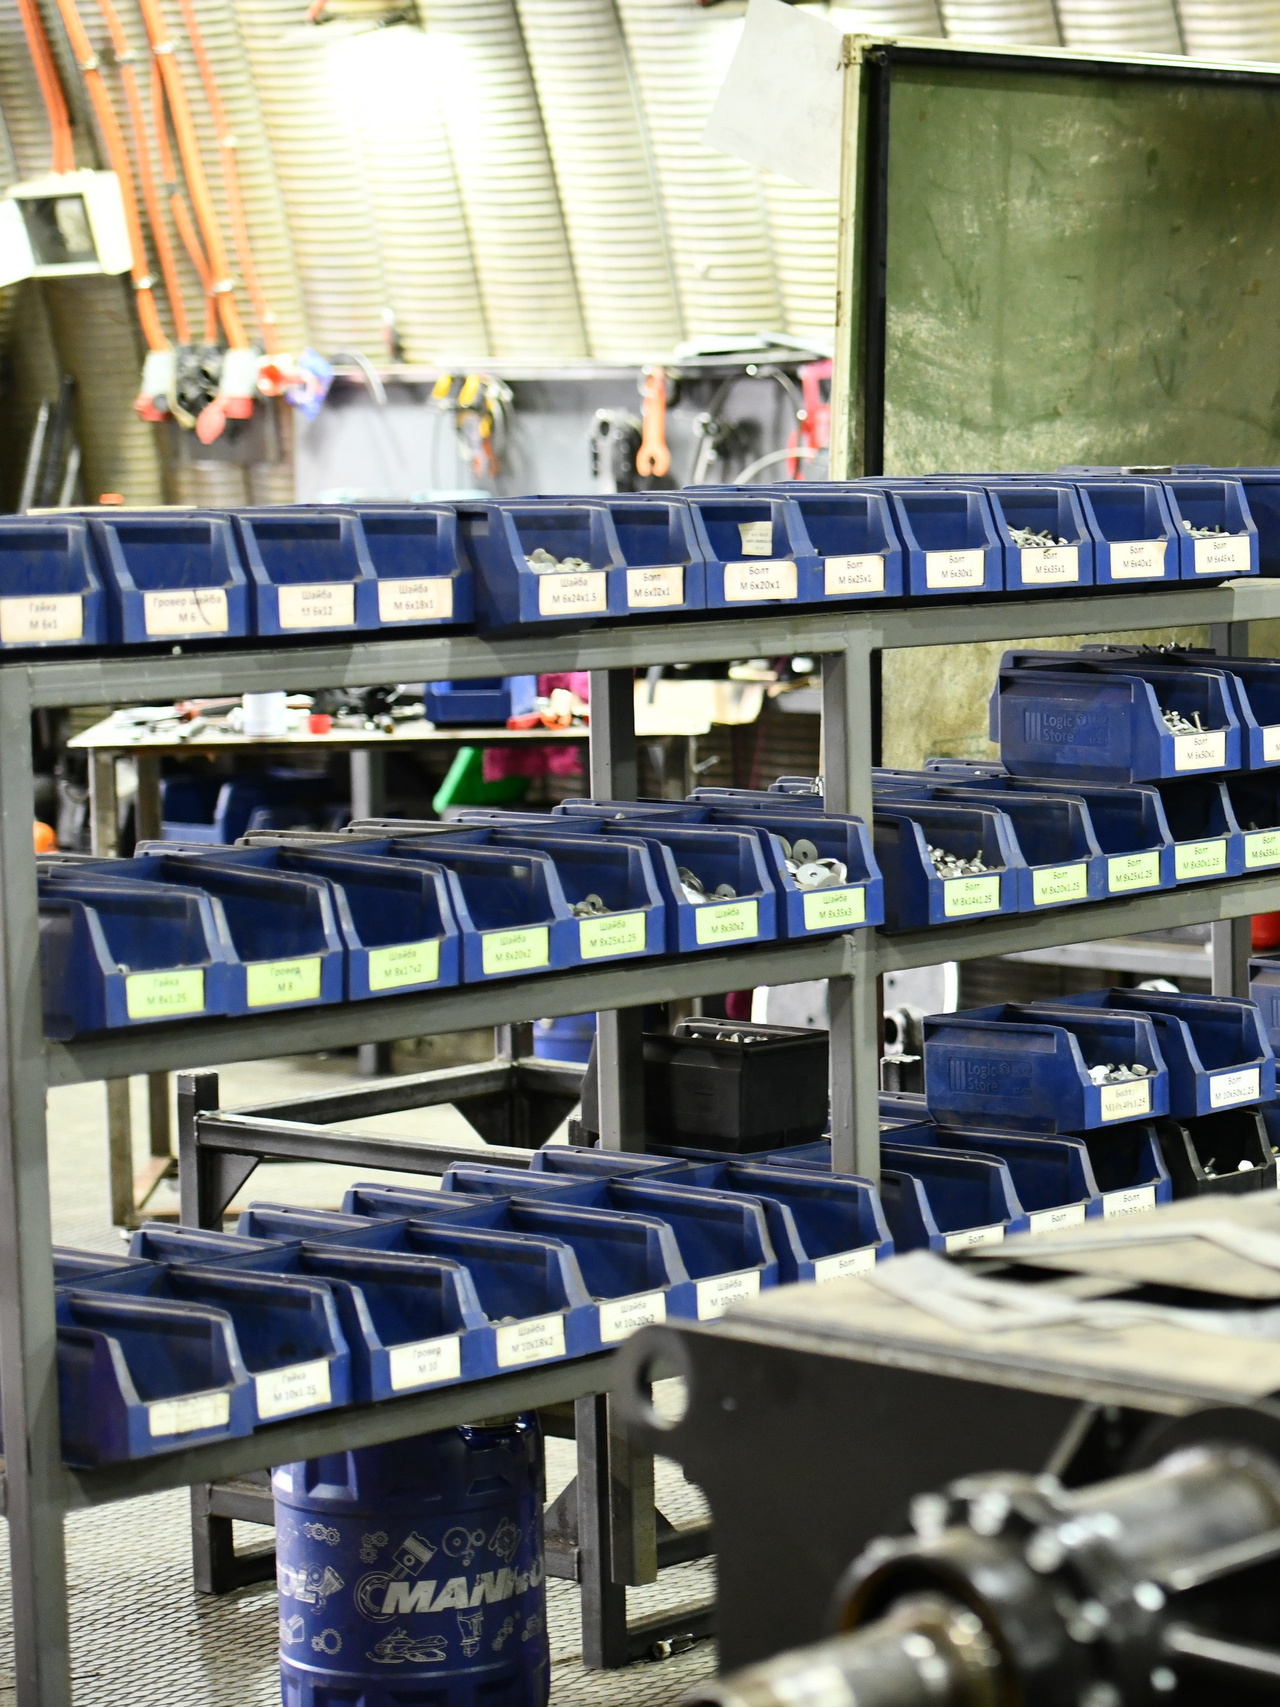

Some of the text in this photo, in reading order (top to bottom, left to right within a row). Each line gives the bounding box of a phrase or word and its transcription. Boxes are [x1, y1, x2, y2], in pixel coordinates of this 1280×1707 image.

[1130, 546, 1144, 555] Болт
[1213, 541, 1227, 550] Болт
[949, 555, 965, 564] Болт
[1043, 551, 1058, 560] Болт
[846, 560, 863, 569] Болт
[749, 566, 769, 576] Болт
[561, 577, 588, 588] Шайба
[643, 573, 661, 582] Болт
[399, 585, 428, 594] Шайба
[302, 590, 332, 600] Шайба
[29, 602, 57, 612] Гайка
[153, 596, 222, 608] Гровер шайба
[1043, 713, 1073, 730] Logic
[1043, 729, 1074, 742] Store
[1194, 738, 1208, 746] Болт
[1262, 836, 1276, 845] Болт
[1194, 847, 1209, 855] Болт
[1127, 859, 1141, 868] Болт
[1053, 871, 1068, 880] Болт
[964, 882, 980, 891] Болт
[822, 893, 848, 905] Шайба
[714, 908, 740, 919] Шайба
[599, 920, 626, 932] Шайба
[500, 935, 526, 945] Шайба
[389, 949, 417, 961] Шайба
[271, 967, 301, 977] Гровер
[967, 1062, 997, 1079] Logic
[967, 1078, 998, 1092] Store
[1228, 1076, 1242, 1085] Болт
[1123, 1194, 1140, 1203] Болт
[1051, 1213, 1068, 1223] Болт
[968, 1235, 985, 1244] Болт
[838, 1259, 855, 1269] Болт
[717, 1279, 743, 1291] Шайба
[620, 1301, 647, 1313] Шайба
[517, 1325, 546, 1337] Шайба
[412, 1347, 441, 1360] Гровер
[282, 1373, 306, 1384] Гайка
